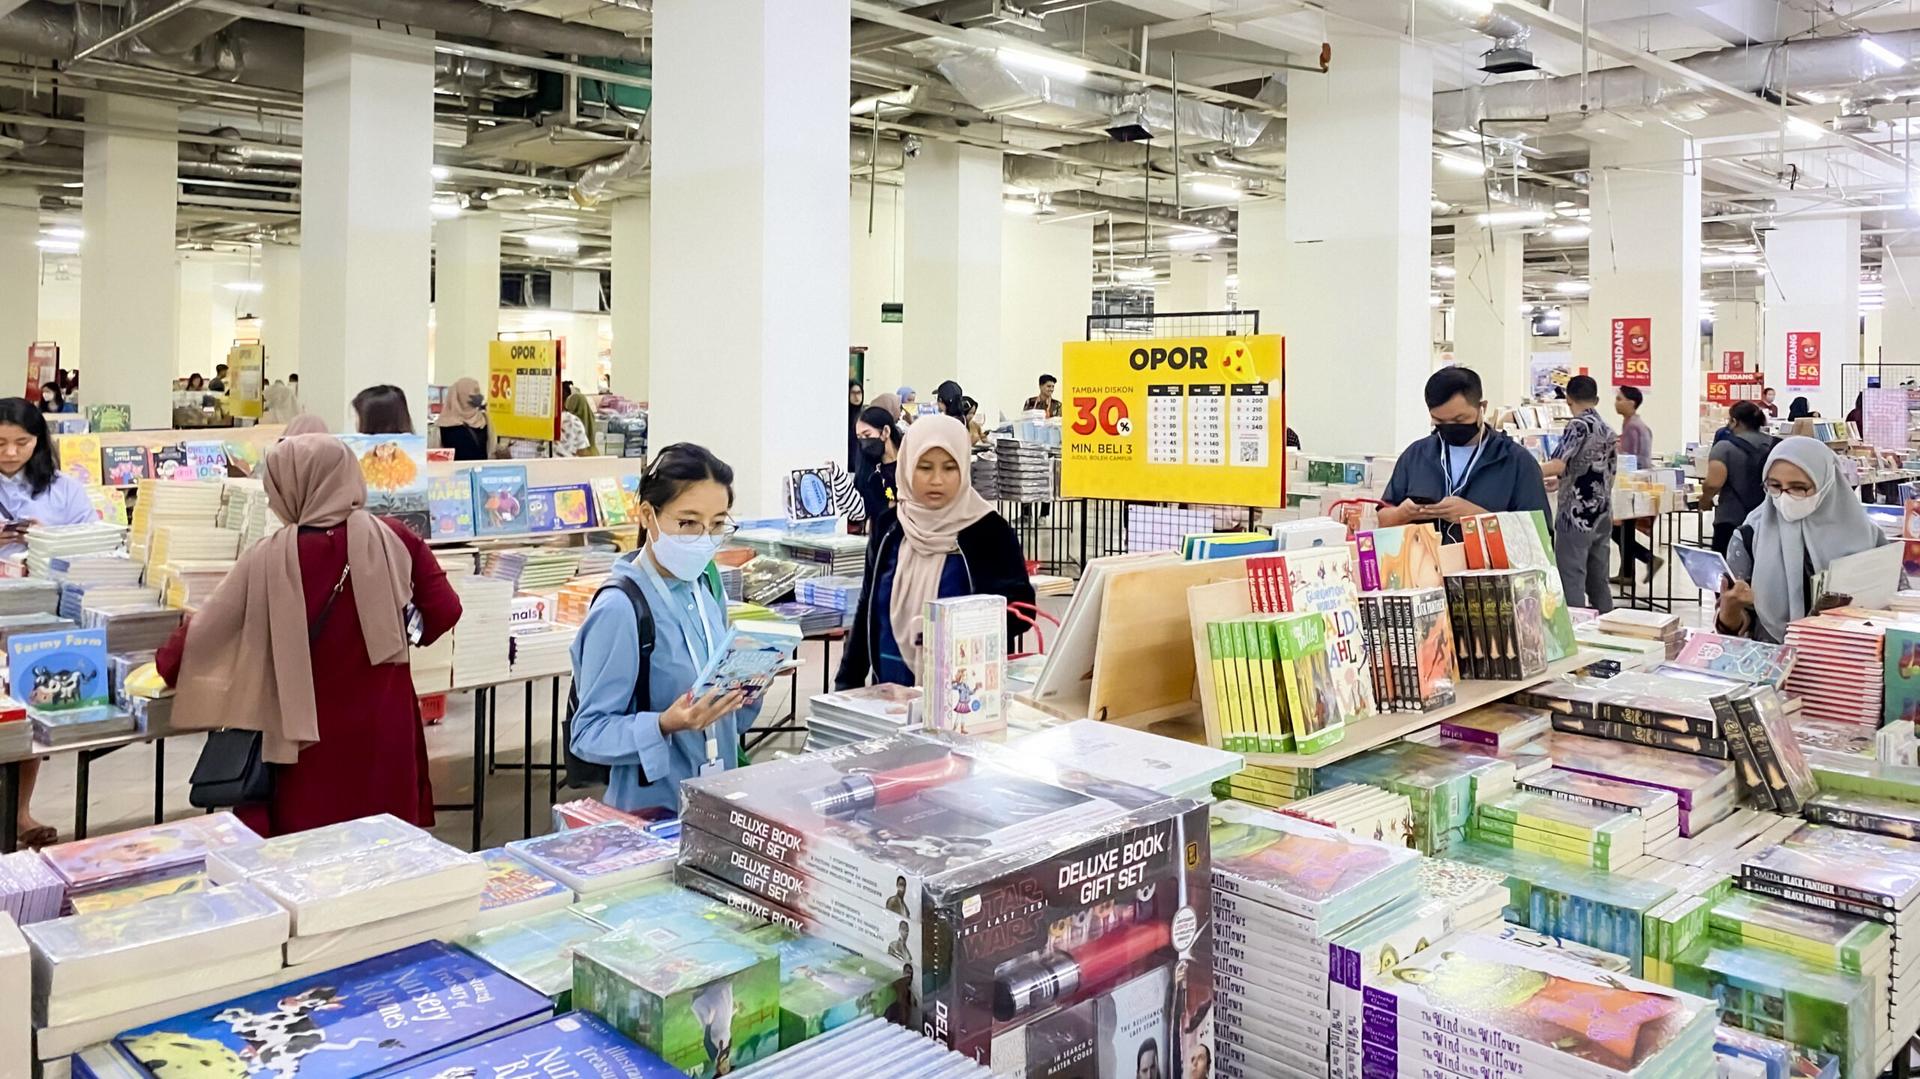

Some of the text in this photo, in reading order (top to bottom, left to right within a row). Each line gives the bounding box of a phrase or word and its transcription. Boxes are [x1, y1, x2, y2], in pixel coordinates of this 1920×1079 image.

[511, 346, 536, 360] OPOR
[1130, 347, 1208, 370] OPOR
[1614, 321, 1624, 378] RENDANG
[1789, 334, 1798, 379] RENDANG
[1071, 396, 1128, 436] 30
[1071, 444, 1132, 454] MIN. BELI 3
[1325, 610, 1355, 638] ALD
[15, 634, 102, 654] Farmy Farm
[1329, 640, 1357, 668] AHL
[730, 810, 770, 837] DELUXE
[771, 828, 801, 852] BOOK
[742, 832, 787, 861] GIFT SET
[1058, 832, 1165, 889] DELUXE BOOK
[731, 852, 770, 879] DELUXE
[773, 870, 803, 893] BOOK
[1080, 862, 1147, 905] GIFT SET
[1754, 869, 1781, 882] SMITH
[1783, 875, 1803, 886] BLACK
[1804, 880, 1835, 894] PANTHER
[743, 873, 788, 903] GIFT SET
[1213, 891, 1236, 910] illows
[1754, 884, 1782, 895] SMITH
[1783, 889, 1804, 902] BLACK
[1805, 894, 1836, 909] PANTHER
[727, 892, 769, 920] DELUXE
[772, 912, 803, 930] BOOK
[957, 900, 1049, 939] THE LAST JEDI
[1214, 905, 1246, 926] Willows
[964, 912, 1044, 962] WARS
[1214, 923, 1246, 943] Willows
[1213, 938, 1244, 959] Willows
[1213, 955, 1243, 976] Willows
[392, 969, 452, 1021] Nursery
[1213, 973, 1245, 995] Willows
[354, 981, 408, 1029] Rhymes
[1120, 1022, 1130, 1033] THE
[1129, 1018, 1160, 1038] LAST STAND
[1214, 1021, 1244, 1044] Willows
[1332, 1022, 1344, 1048] Wind
[1421, 1011, 1520, 1054] The Wind in the Willows
[1054, 1053, 1061, 1064] IN
[1063, 1042, 1086, 1059] SEARCH
[1214, 1038, 1245, 1061] Willows
[1346, 1028, 1360, 1056] Wind
[1422, 1030, 1432, 1042] The
[1433, 1032, 1459, 1054] Wind
[1469, 1048, 1479, 1058] the
[1480, 1048, 1523, 1074] Willows
[576, 1046, 619, 1079] Treasu
[604, 1045, 644, 1079] Illustra
[1048, 1060, 1071, 1076] MASTER
[1422, 1048, 1432, 1060] The
[1433, 1050, 1460, 1072] Wind
[1469, 1067, 1479, 1076] the
